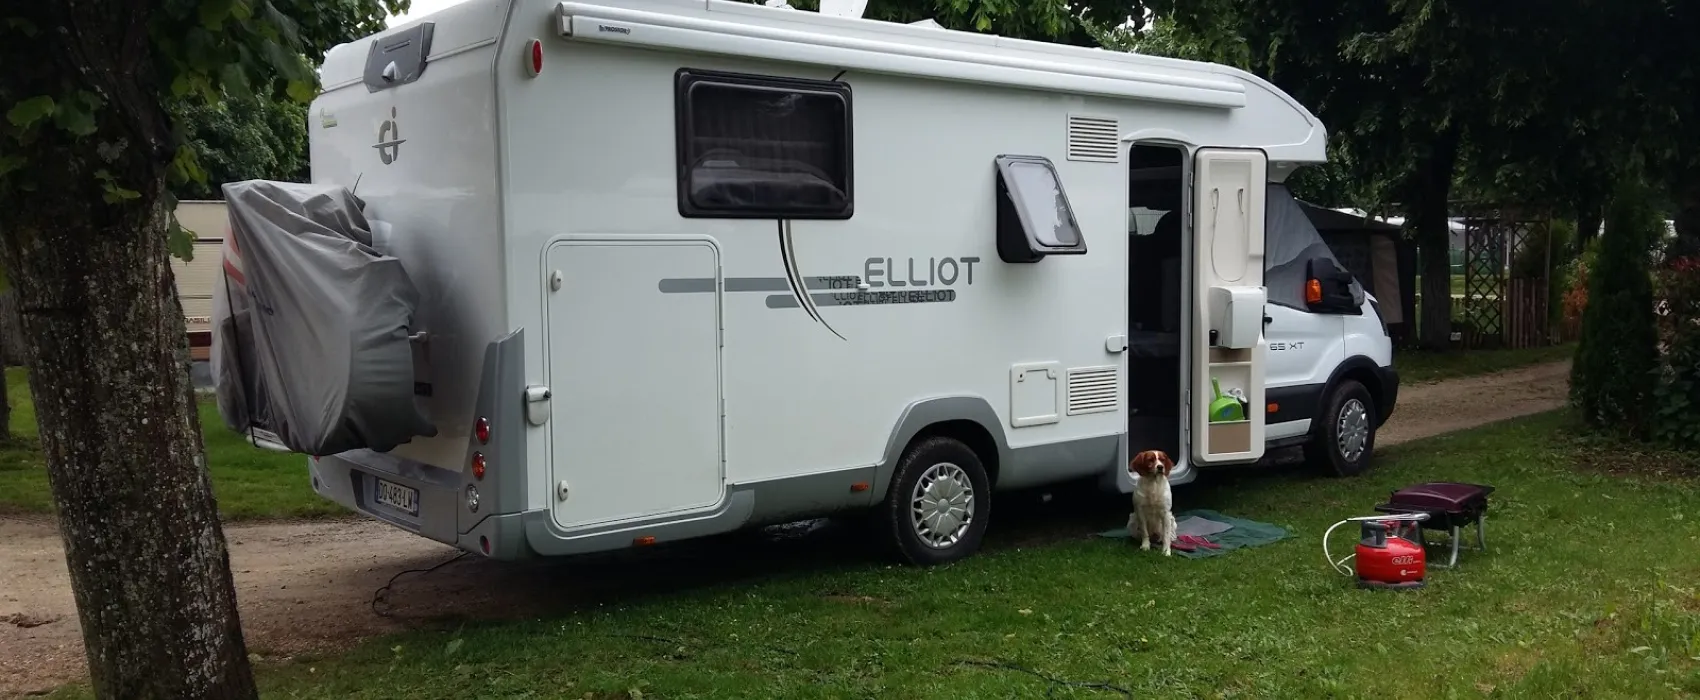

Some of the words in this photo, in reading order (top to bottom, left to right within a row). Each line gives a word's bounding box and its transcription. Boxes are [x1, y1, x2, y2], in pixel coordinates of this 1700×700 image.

[864, 256, 981, 288] ELLIOT
[1269, 342, 1286, 351] 65
[1289, 341, 1305, 350] XT
